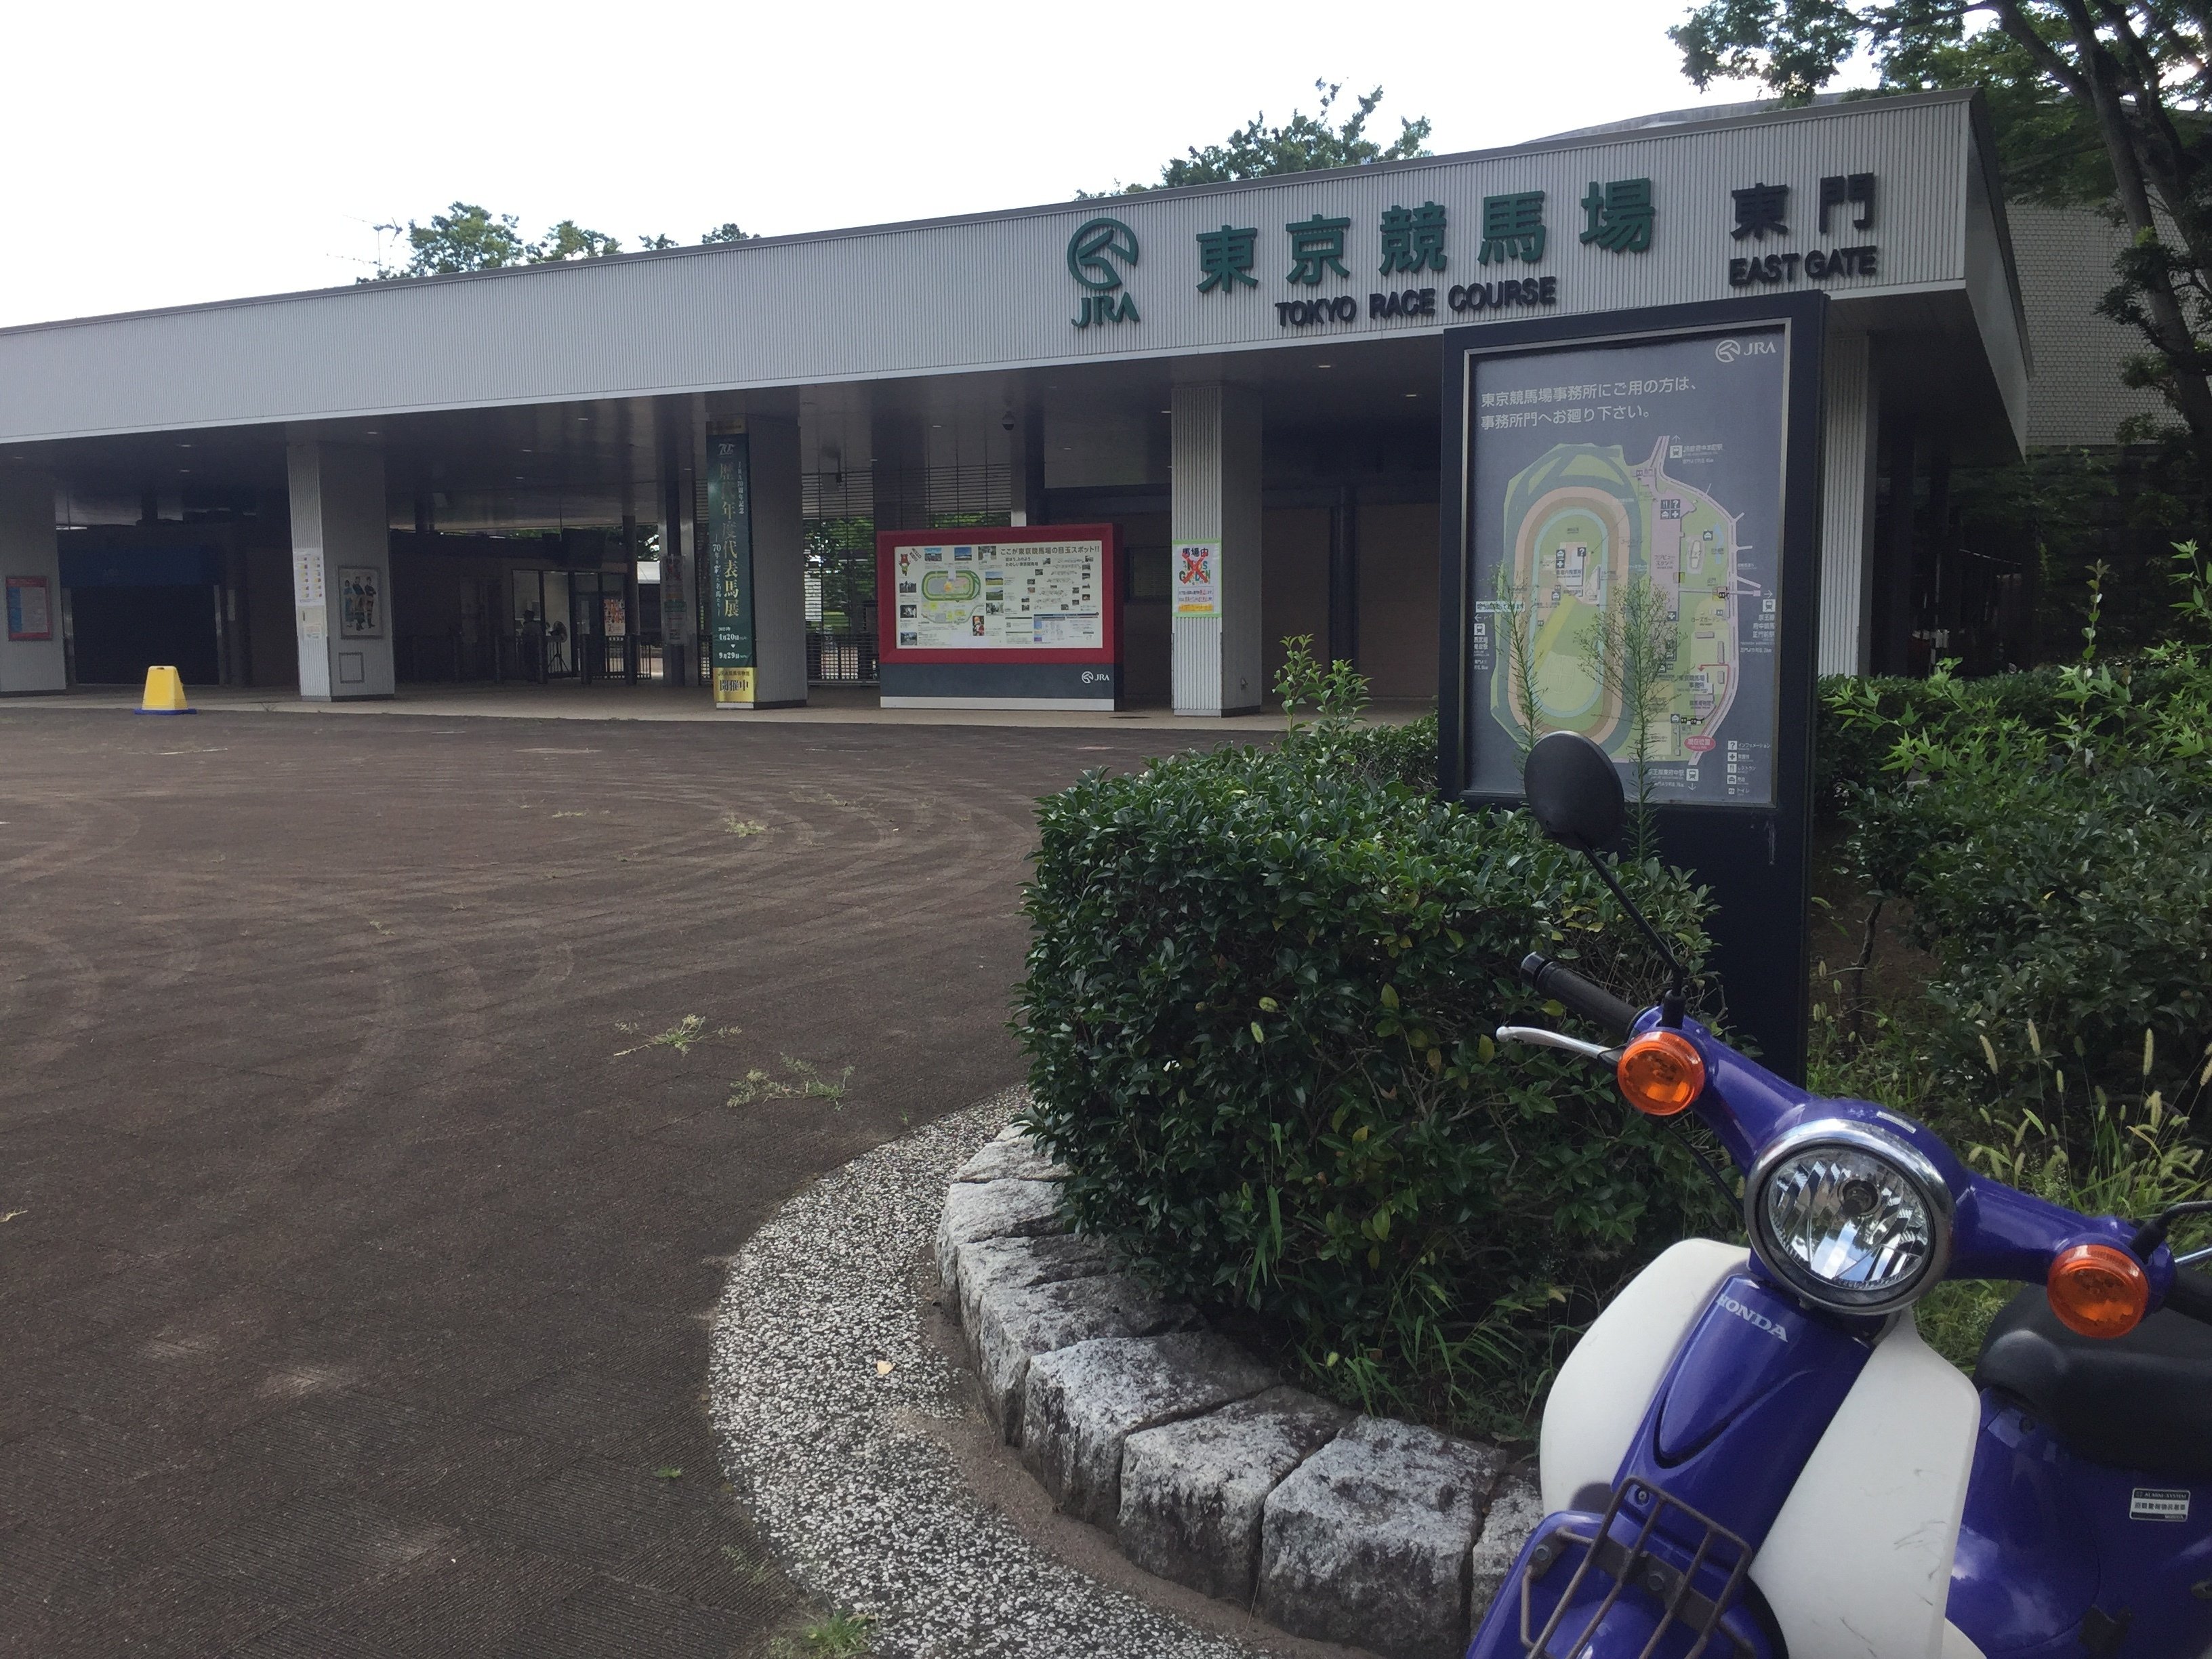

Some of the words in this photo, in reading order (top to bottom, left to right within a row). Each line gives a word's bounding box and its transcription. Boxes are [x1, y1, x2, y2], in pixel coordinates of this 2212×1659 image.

[1731, 172, 1875, 241] 東門
[1196, 177, 1655, 294] 東京競馬場
[1729, 252, 1799, 287] EAST
[1804, 245, 1877, 280] GATE
[1071, 292, 1140, 329] JRA
[1275, 295, 1356, 327] TOKYO
[1370, 287, 1436, 319] RACE
[1448, 276, 1557, 312] COURSE
[1743, 340, 1777, 356] JRA
[1480, 376, 1696, 408] 東京競馬場事務所にご用の方は、
[1480, 404, 1650, 430] 事務所門へお廻り下さい。
[1094, 673, 1110, 682] JRA
[1715, 1293, 1788, 1343] HONDA
